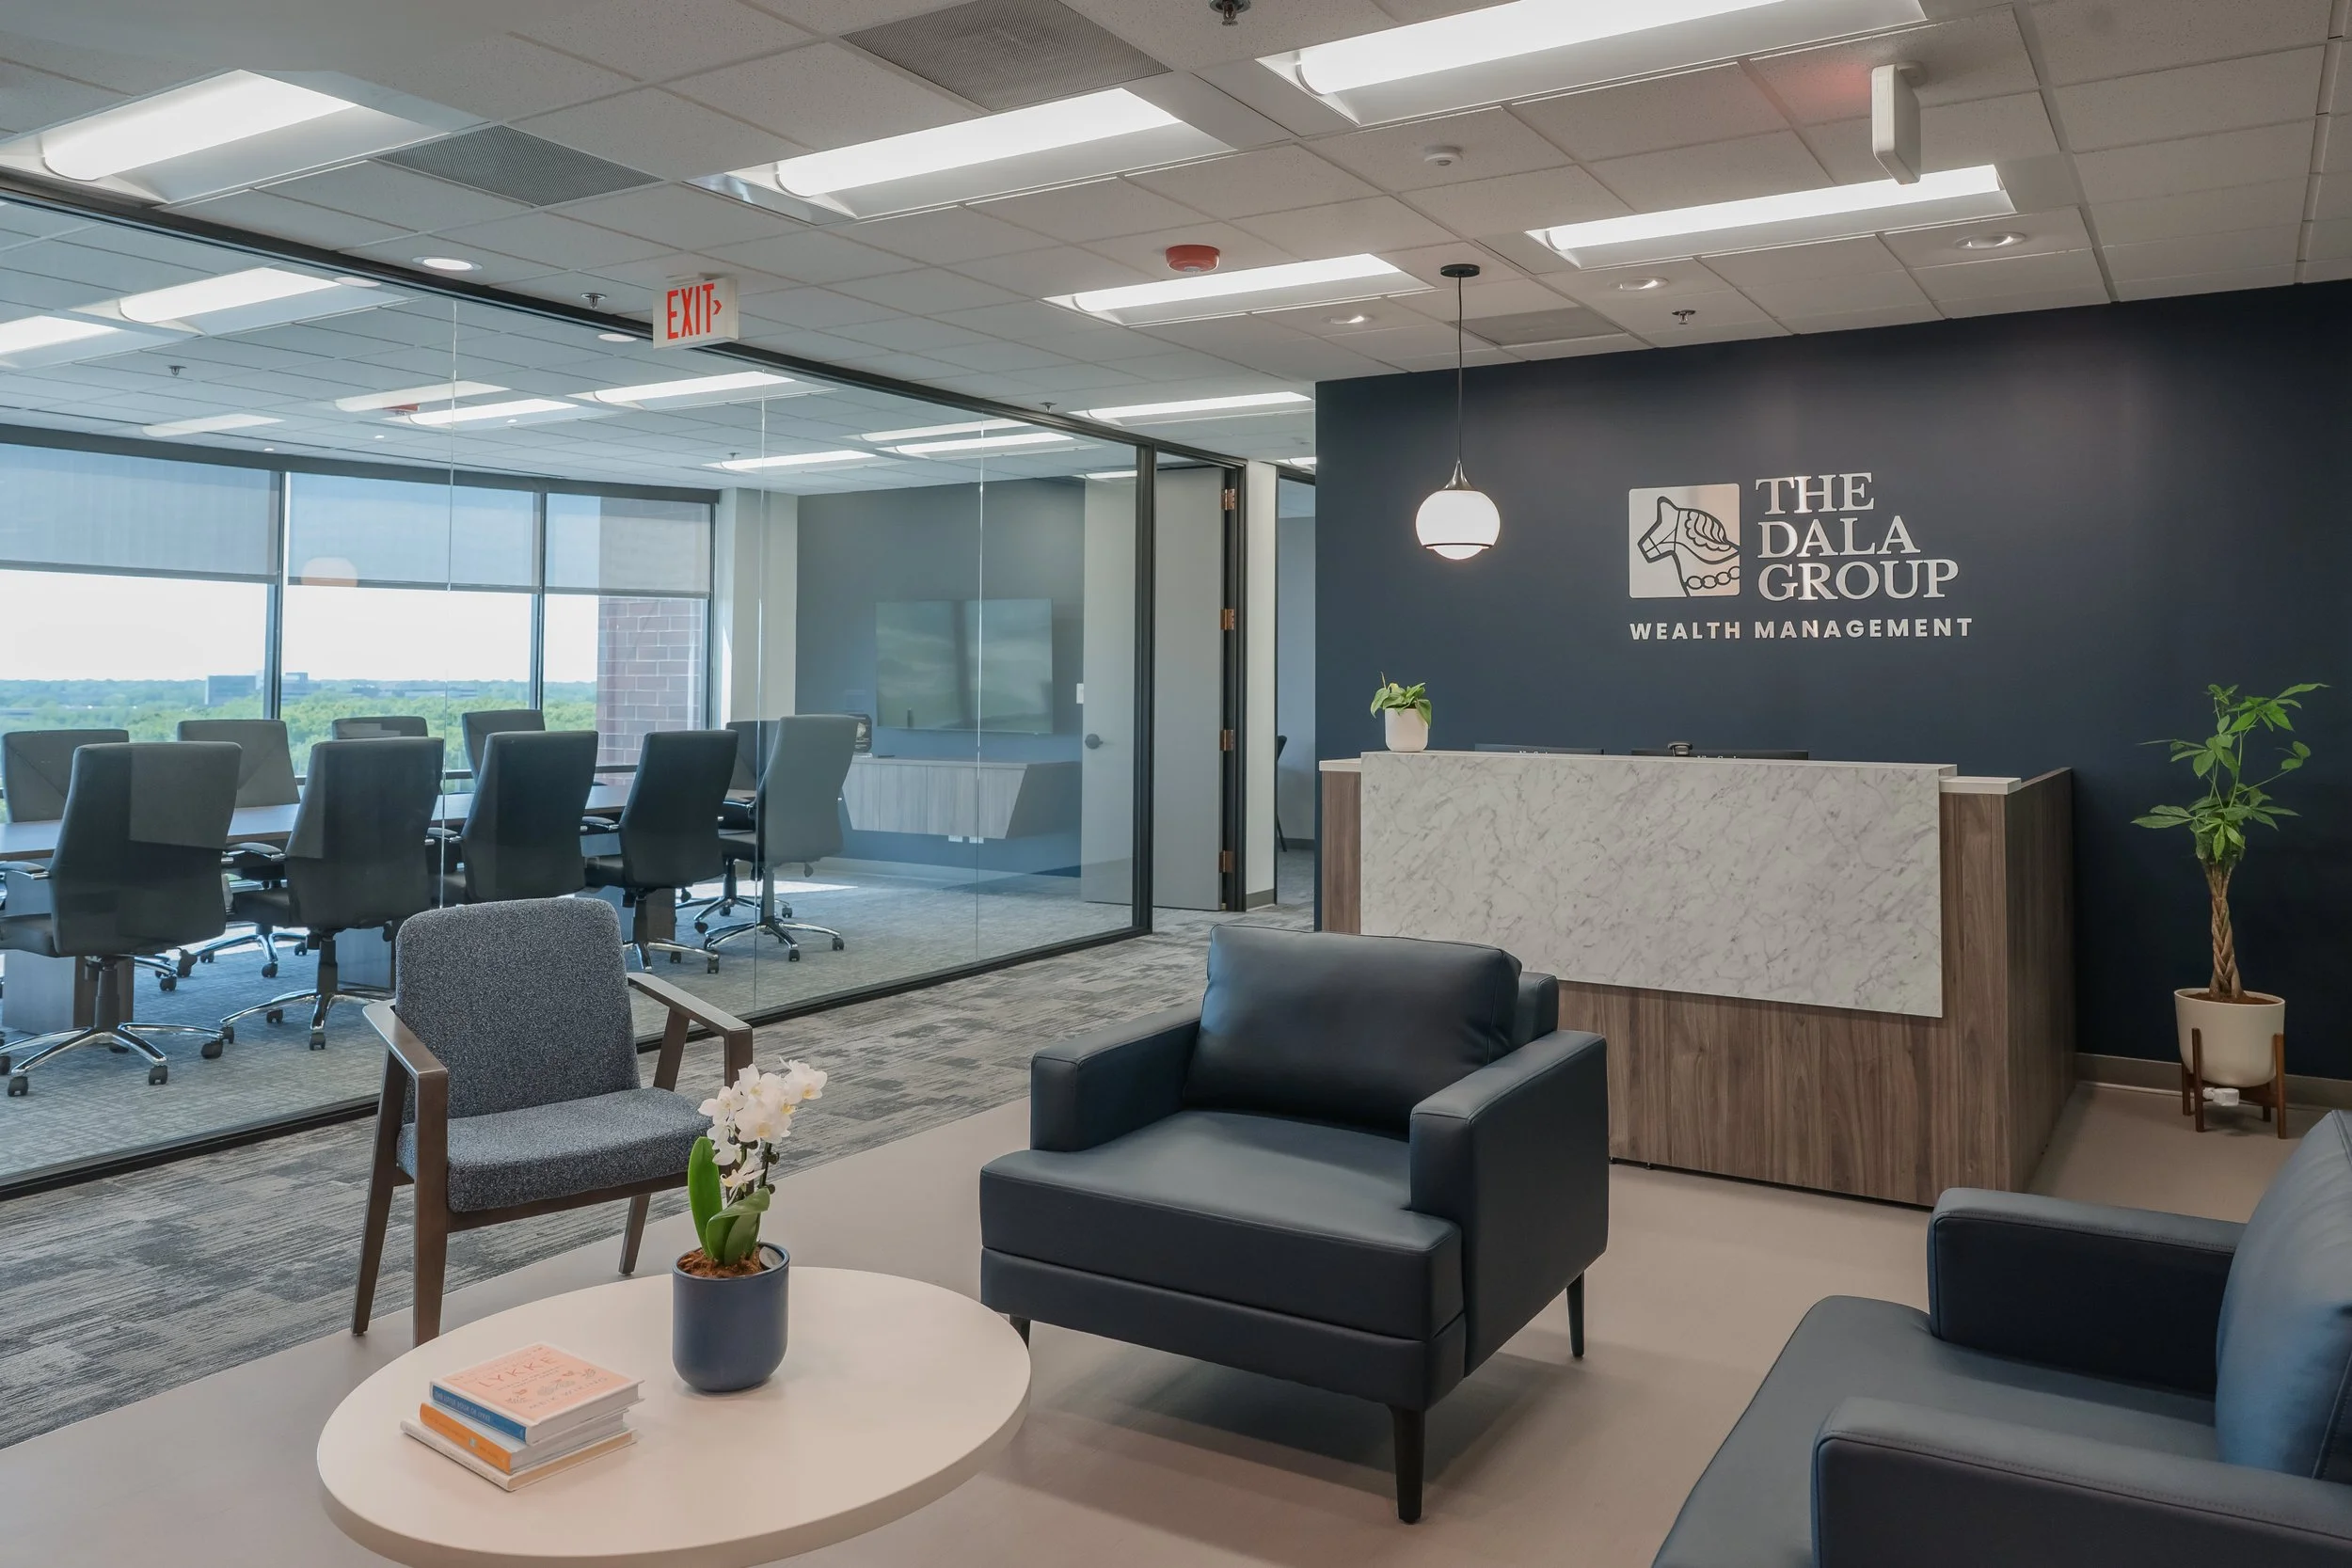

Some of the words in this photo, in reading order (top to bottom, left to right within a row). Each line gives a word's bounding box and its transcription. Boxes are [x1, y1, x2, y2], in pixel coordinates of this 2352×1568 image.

[666, 283, 715, 340] EXIT
[1755, 472, 1875, 515] THE
[1756, 515, 1921, 559] DALA
[1757, 558, 1960, 601] GROUP
[1629, 621, 1741, 641] WEALTH
[1755, 617, 1973, 640] MANAGEMENT
[477, 1356, 559, 1388] LYKKE
